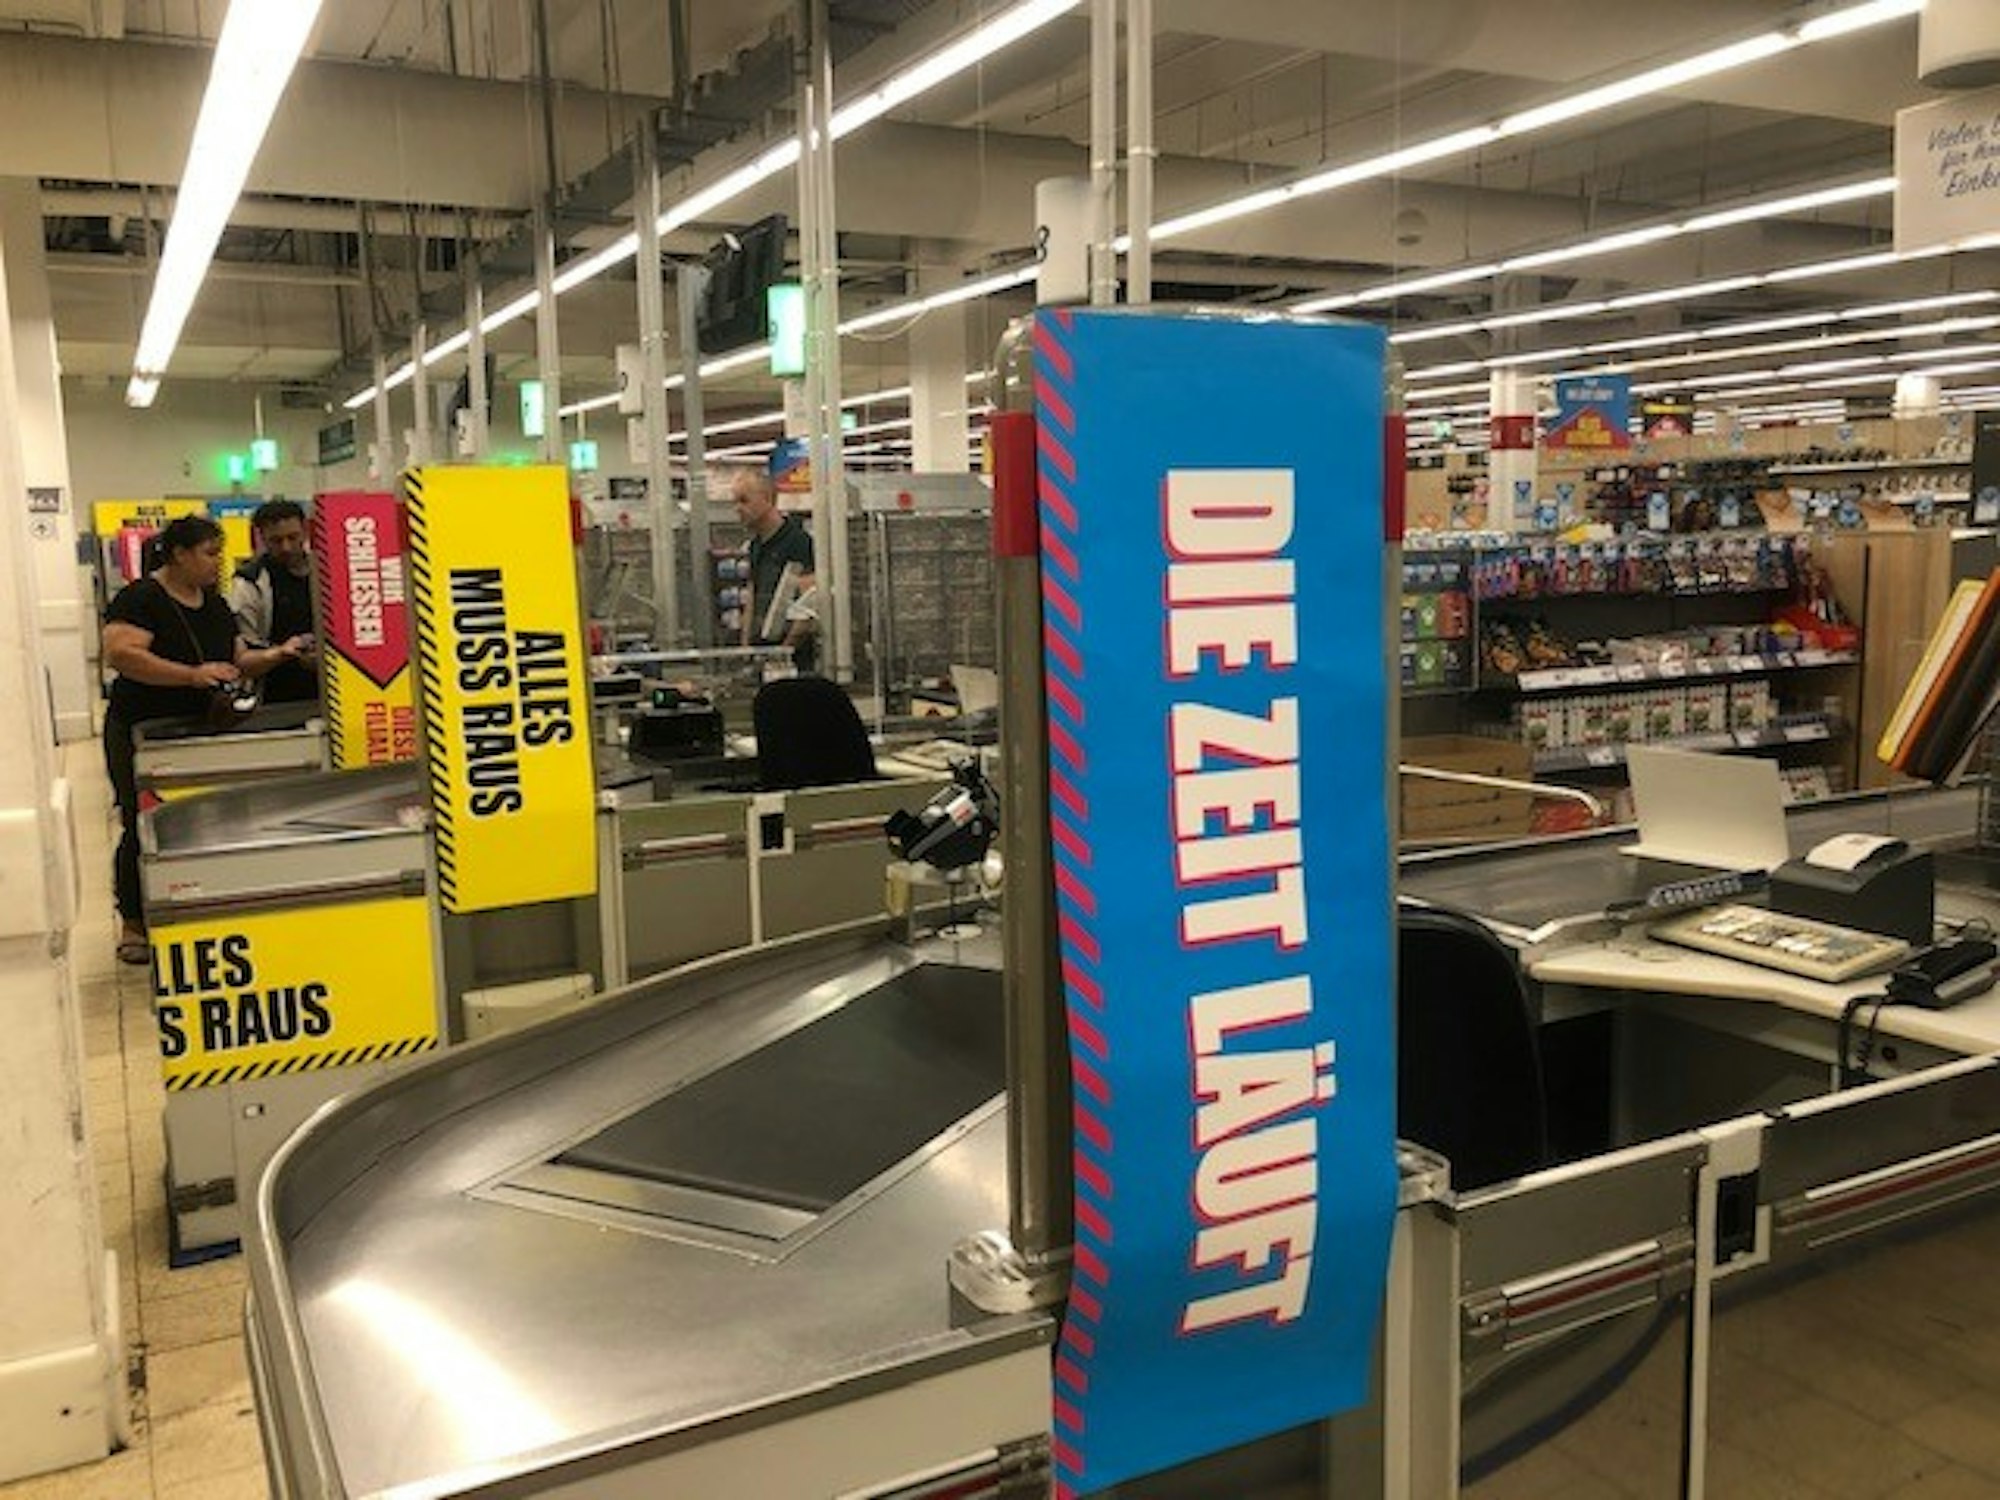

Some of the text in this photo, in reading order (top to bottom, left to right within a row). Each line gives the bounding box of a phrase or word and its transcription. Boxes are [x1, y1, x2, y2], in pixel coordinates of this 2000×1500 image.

[344, 516, 385, 647] SCHLIESSEN
[380, 555, 405, 605] WIR
[449, 568, 522, 817] MUSS RAUS
[514, 631, 574, 747] ALLES
[1161, 468, 1337, 1336] DIE ZEIT LÄUFT
[200, 982, 332, 1052] RAUS
